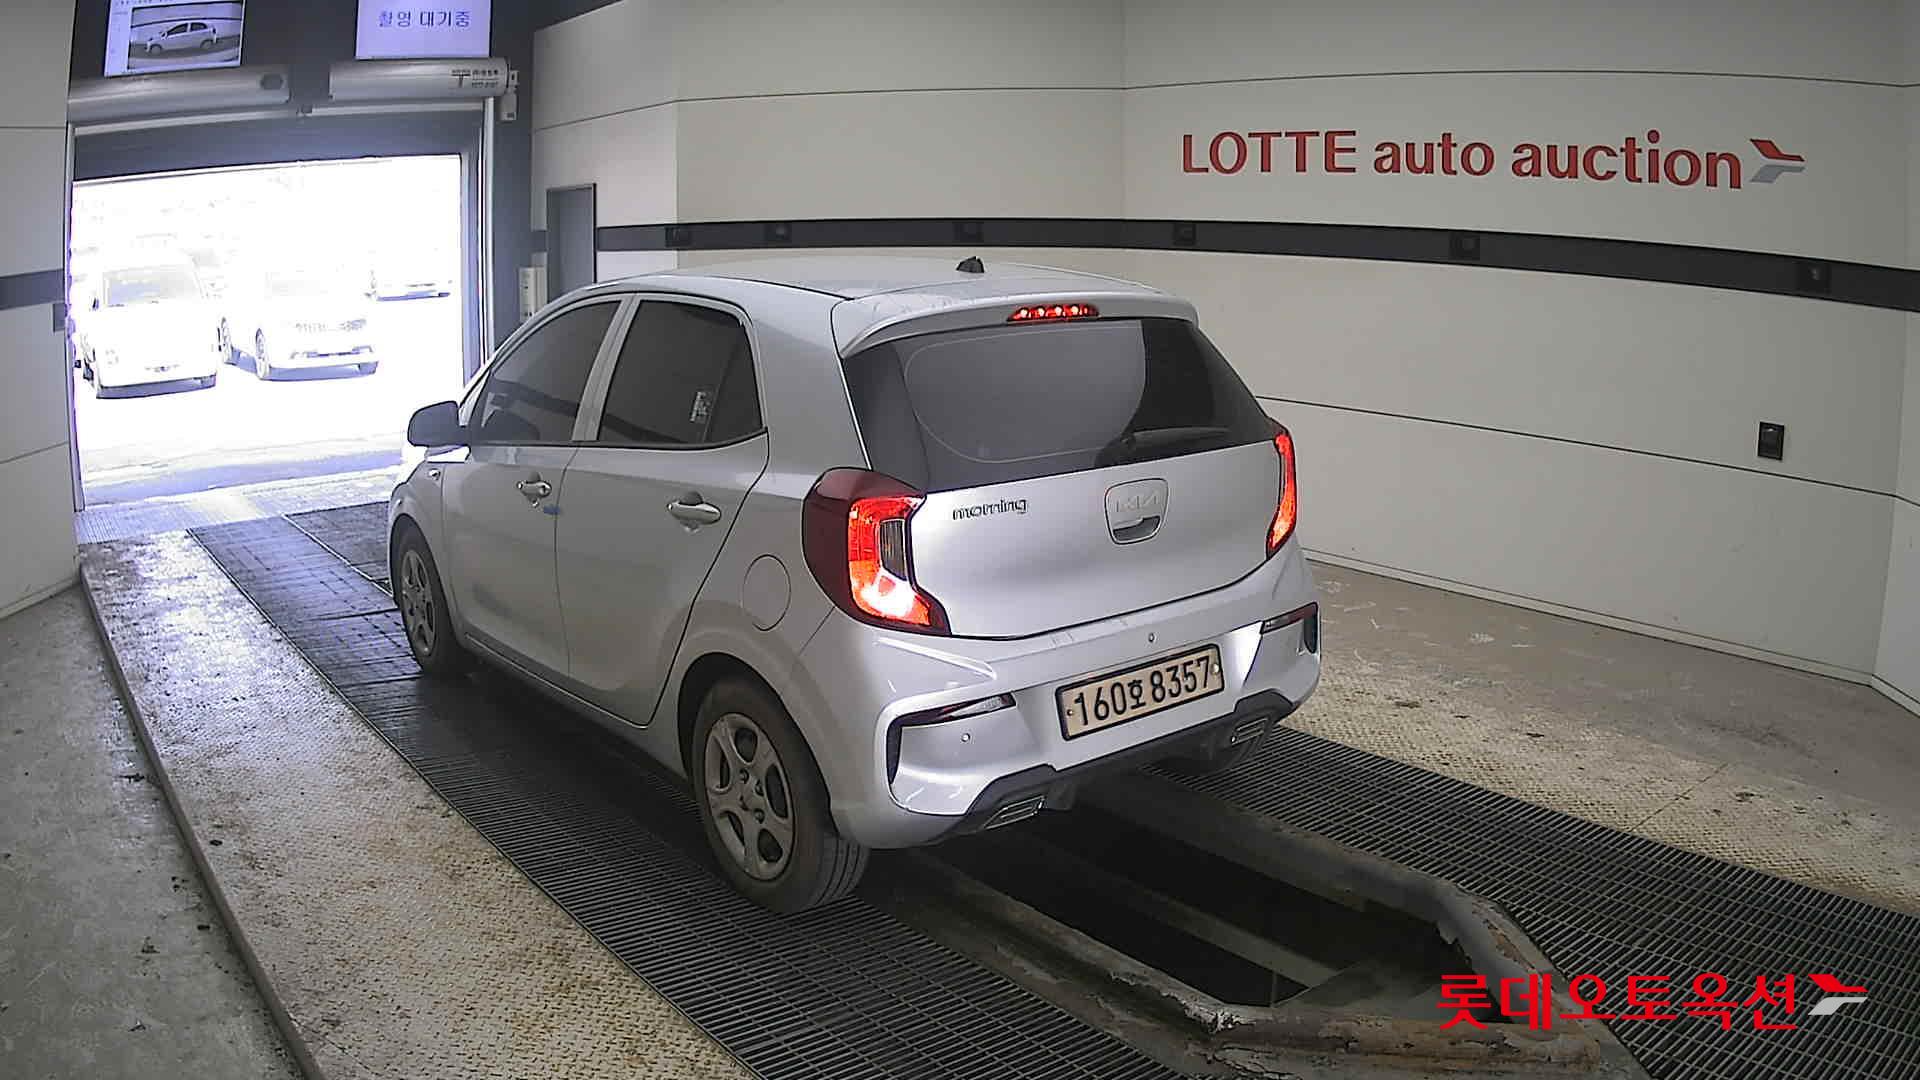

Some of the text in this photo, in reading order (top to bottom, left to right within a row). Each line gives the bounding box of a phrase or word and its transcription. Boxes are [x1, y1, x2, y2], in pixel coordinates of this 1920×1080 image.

[419, 10, 471, 28] 대기중
[1183, 129, 1743, 189] LOTTE auto auction
[952, 497, 1028, 520] morning
[1073, 655, 1211, 726] 160호 8357
